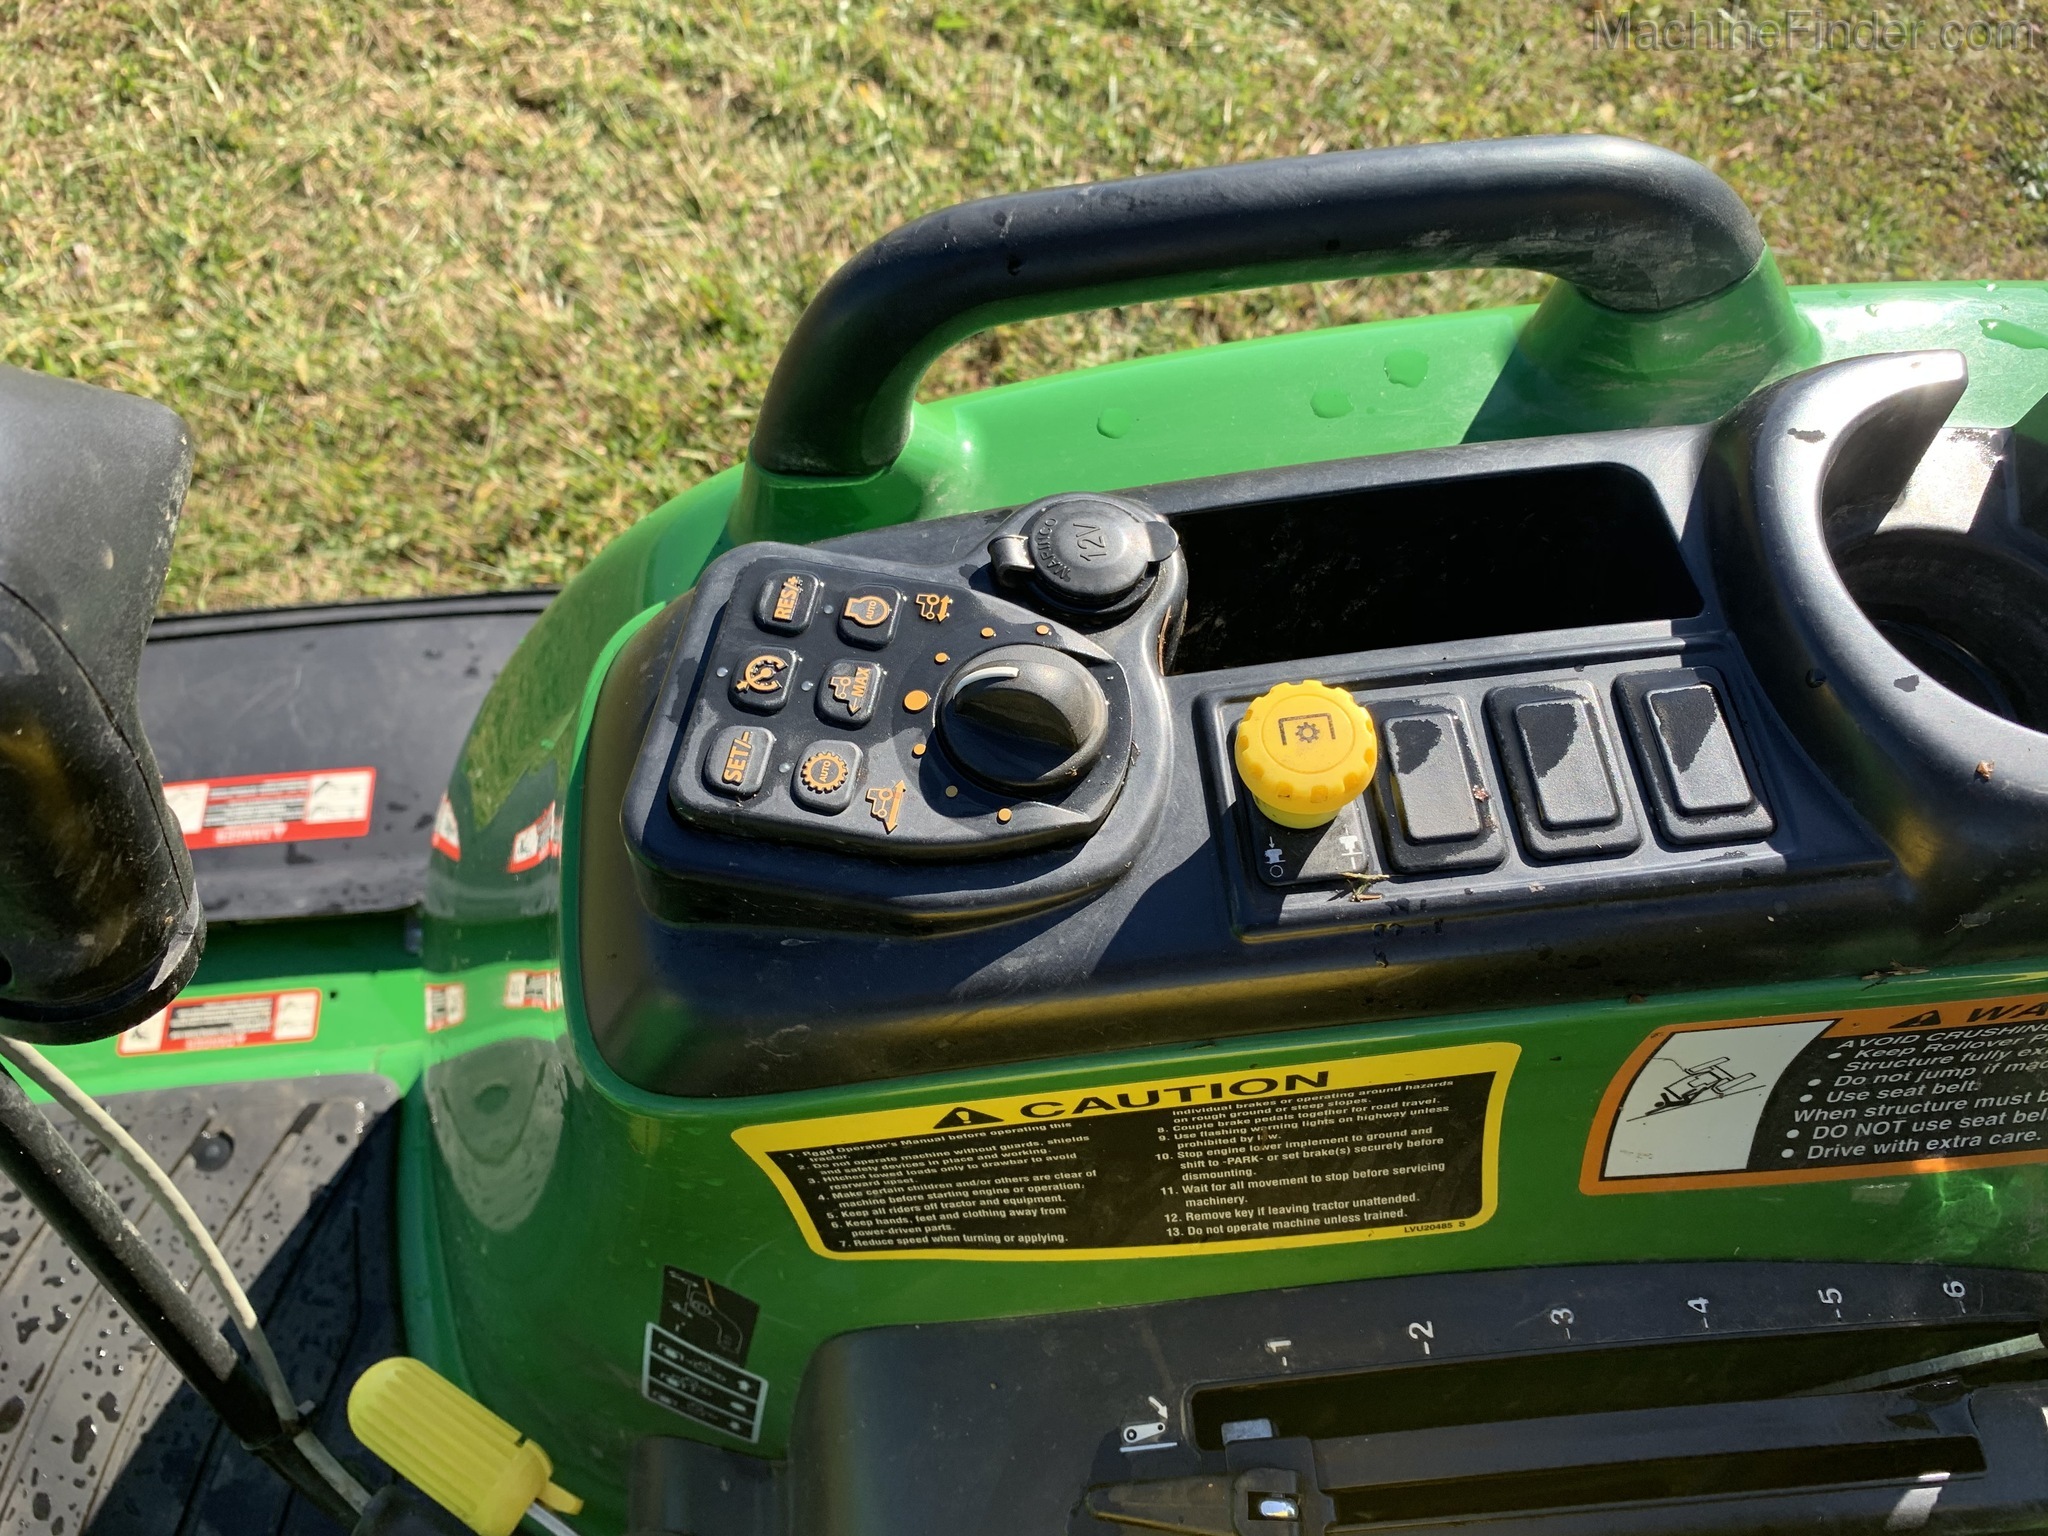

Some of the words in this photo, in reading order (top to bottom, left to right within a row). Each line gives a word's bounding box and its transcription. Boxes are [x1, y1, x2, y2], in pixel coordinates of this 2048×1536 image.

[1073, 523, 1107, 562] 12V
[773, 576, 799, 620] RES/+
[866, 600, 877, 620] AUTO
[851, 666, 872, 697] MAX
[819, 760, 831, 782] AUTO
[1837, 1034, 1921, 1049] AVOID
[1854, 1046, 1917, 1059] Keep
[1922, 1037, 2024, 1053] Rollover
[2028, 1034, 2048, 1044] P
[1843, 1055, 1954, 1072] Structure
[1960, 1050, 2013, 1062] fully
[2017, 1046, 2048, 1057] ex
[1834, 1075, 1866, 1087] Do
[1872, 1071, 1911, 1084] not
[1914, 1067, 1977, 1083] jump
[1982, 1063, 2002, 1074] if
[1020, 1071, 1329, 1118] CAUTION
[1826, 1090, 1870, 1103] Use
[1876, 1085, 1927, 1100] seat
[1931, 1080, 1979, 1095] belt.
[1172, 1122, 1214, 1131] Couple
[1217, 1118, 1250, 1127] brake
[1254, 1113, 1294, 1124] pedals
[1297, 1108, 1348, 1118] together
[1371, 1101, 1398, 1110] road
[1402, 1097, 1439, 1107] travel.
[1191, 1112, 1226, 1121] rough
[1229, 1107, 1271, 1118] ground
[1291, 1102, 1324, 1110] steep
[1327, 1098, 1371, 1107] slopes.
[1794, 1108, 1857, 1122] When
[1864, 1099, 1968, 1118] structure
[1974, 1091, 2032, 1108] must
[1173, 1132, 1196, 1140] Use
[1199, 1127, 1247, 1137] flashing
[1302, 1118, 1335, 1127] lights
[1356, 1110, 1406, 1121] highway
[1410, 1105, 1449, 1115] unless
[1812, 1124, 1848, 1140] DO
[1855, 1120, 1907, 1137] NOT
[1912, 1118, 1953, 1132] use
[1958, 1112, 2007, 1128] seat
[2012, 1107, 2048, 1124] bel
[1155, 1152, 1173, 1160] 10.
[1177, 1150, 1203, 1158] Stop
[1206, 1146, 1246, 1156] engine
[1285, 1135, 1348, 1148] implement
[1351, 1134, 1363, 1142] to
[1366, 1129, 1407, 1141] ground
[1410, 1126, 1432, 1135] and
[1177, 1136, 1236, 1150] prohibited
[1180, 1160, 1205, 1169] shift
[1281, 1151, 1299, 1160] set
[1302, 1145, 1350, 1158] brake(s)
[1354, 1141, 1403, 1153] securely
[1406, 1137, 1444, 1147] before
[1807, 1144, 1866, 1159] Drive
[1873, 1138, 1919, 1154] with
[1925, 1135, 1982, 1150] extra
[1989, 1130, 2042, 1145] care.
[829, 1179, 880, 1190] rearward
[882, 1177, 917, 1185] upset.
[831, 1191, 863, 1199] Make
[865, 1186, 904, 1195] certain
[907, 1182, 953, 1191] children
[955, 1179, 991, 1187] and/or
[994, 1176, 1029, 1184] others
[1085, 1169, 1096, 1177] of
[1160, 1186, 1179, 1195] 11.
[1182, 1184, 1208, 1194] Wait
[1210, 1183, 1226, 1191] for
[1229, 1180, 1244, 1190] all
[1247, 1175, 1308, 1188] movement
[1310, 1174, 1322, 1183] to
[1325, 1172, 1349, 1181] stop
[1352, 1168, 1389, 1179] before
[1392, 1162, 1445, 1175] servicing
[1182, 1168, 1256, 1181] dismounting.
[838, 1198, 886, 1208] machine
[888, 1194, 924, 1203] before
[926, 1190, 969, 1199] starting
[972, 1187, 1010, 1196] engine
[871, 1207, 886, 1215] all
[888, 1205, 921, 1214] riders
[923, 1202, 938, 1210] off
[940, 1200, 976, 1209] tractor
[979, 1197, 1000, 1205] and
[1002, 1194, 1065, 1206] equipment.
[1164, 1212, 1182, 1222] 12.
[1185, 1210, 1231, 1221] Remove
[1234, 1208, 1254, 1219] key
[1257, 1206, 1265, 1216] if
[1268, 1203, 1309, 1215] leaving
[1312, 1200, 1349, 1211] tractor
[1352, 1192, 1419, 1207] unattended.
[1185, 1195, 1248, 1207] machinery.
[845, 1219, 873, 1227] Keep
[875, 1216, 913, 1225] hands,
[915, 1213, 937, 1222] feet
[939, 1211, 960, 1220] and
[962, 1209, 1006, 1218] clothing
[1008, 1208, 1037, 1217] away
[1040, 1207, 1066, 1215] from
[1166, 1227, 1184, 1237] 13.
[1187, 1226, 1203, 1235] Do
[1206, 1224, 1224, 1234] not
[1226, 1221, 1269, 1234] operate
[1272, 1217, 1320, 1229] machine
[1323, 1214, 1360, 1224] unless
[1363, 1207, 1407, 1221] trained.
[1404, 1222, 1453, 1233] LVU20485
[851, 1226, 922, 1238] power-driven
[924, 1223, 955, 1233] parts.
[853, 1238, 894, 1246] Reduce
[896, 1235, 929, 1245] speed
[931, 1234, 960, 1242] when
[962, 1233, 1001, 1244] turning
[1017, 1232, 1068, 1244] applying.
[1818, 1288, 1843, 1304] 5
[1943, 1281, 1966, 1298] 6
[1687, 1296, 1709, 1314] 4
[1550, 1308, 1574, 1326] 3
[1409, 1320, 1434, 1339] 2
[1266, 1339, 1291, 1352] 1
